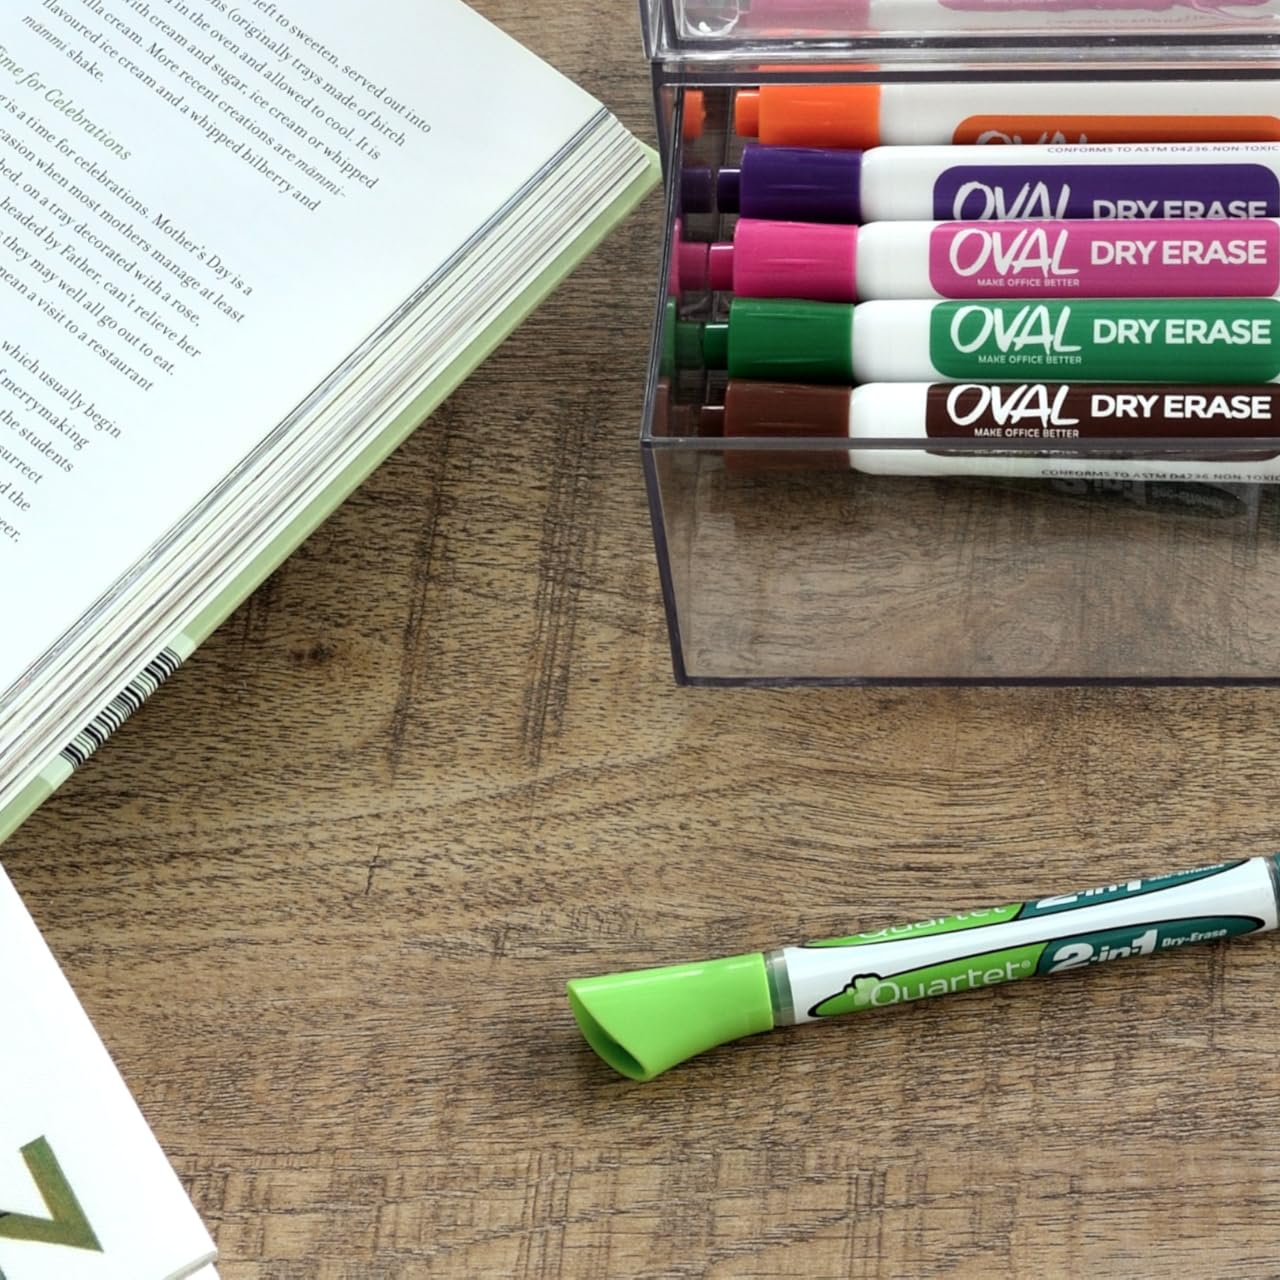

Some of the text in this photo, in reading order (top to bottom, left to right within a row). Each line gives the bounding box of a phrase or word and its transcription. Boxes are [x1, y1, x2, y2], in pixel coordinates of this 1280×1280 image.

[66, 49, 104, 83] shake.
[104, 13, 142, 47] cream.
[146, 42, 179, 72] More
[178, 70, 220, 103] recent
[218, 101, 275, 145] creations
[273, 144, 296, 162] are
[173, 0, 189, 16] in
[188, 12, 211, 31] the
[210, 30, 240, 56] oven
[239, 52, 268, 73] and
[263, 70, 315, 109] allowed
[311, 105, 325, 118] to
[325, 117, 355, 142] cool.
[355, 136, 368, 151] It
[366, 146, 381, 160] is
[275, 14, 289, 27] to
[341, 65, 387, 99] served
[383, 96, 406, 114] out
[404, 109, 431, 133] into
[20, 72, 131, 160] for Celebrations
[98, 39, 119, 58] ice
[118, 57, 156, 88] cream
[156, 86, 184, 107] and
[180, 105, 189, 114] a
[190, 111, 245, 154] whipped
[241, 148, 294, 193] bilberry
[292, 190, 321, 211] and
[149, 15, 188, 47] cream
[187, 44, 216, 66] and
[248, 89, 269, 109] ice
[269, 107, 308, 139] cream
[308, 136, 324, 149] or
[323, 146, 379, 189] whipped
[291, 58, 323, 85] trays
[321, 82, 357, 110] made
[357, 109, 376, 120] of
[370, 113, 405, 147] birch
[1047, 146, 1113, 154] CONFORMS
[1134, 145, 1168, 153] ASTM
[4, 99, 18, 113] is
[16, 111, 26, 120] a
[26, 117, 56, 143] time
[54, 138, 76, 157] for
[74, 156, 149, 219] celebrations.
[151, 213, 207, 261] Mother's
[206, 254, 232, 280] Day
[230, 274, 244, 289] is
[243, 287, 252, 296] a
[952, 181, 1267, 220] OVAL DRY ERASE
[949, 227, 1267, 278] OVAL DRY ERASE
[977, 278, 1080, 287] MAKE OFFICE BETTER
[950, 304, 1271, 354] OVAL DRY ERASE
[978, 355, 1082, 365] MAKE OFFICE BETTER
[2, 341, 121, 438] which usually begin
[946, 384, 1272, 428] OVAL DRY ERASE
[974, 428, 1080, 439] MAKE OFFICE BETTER
[1049, 929, 1158, 974] 2-in-1
[1162, 929, 1228, 948] Dry-Erase
